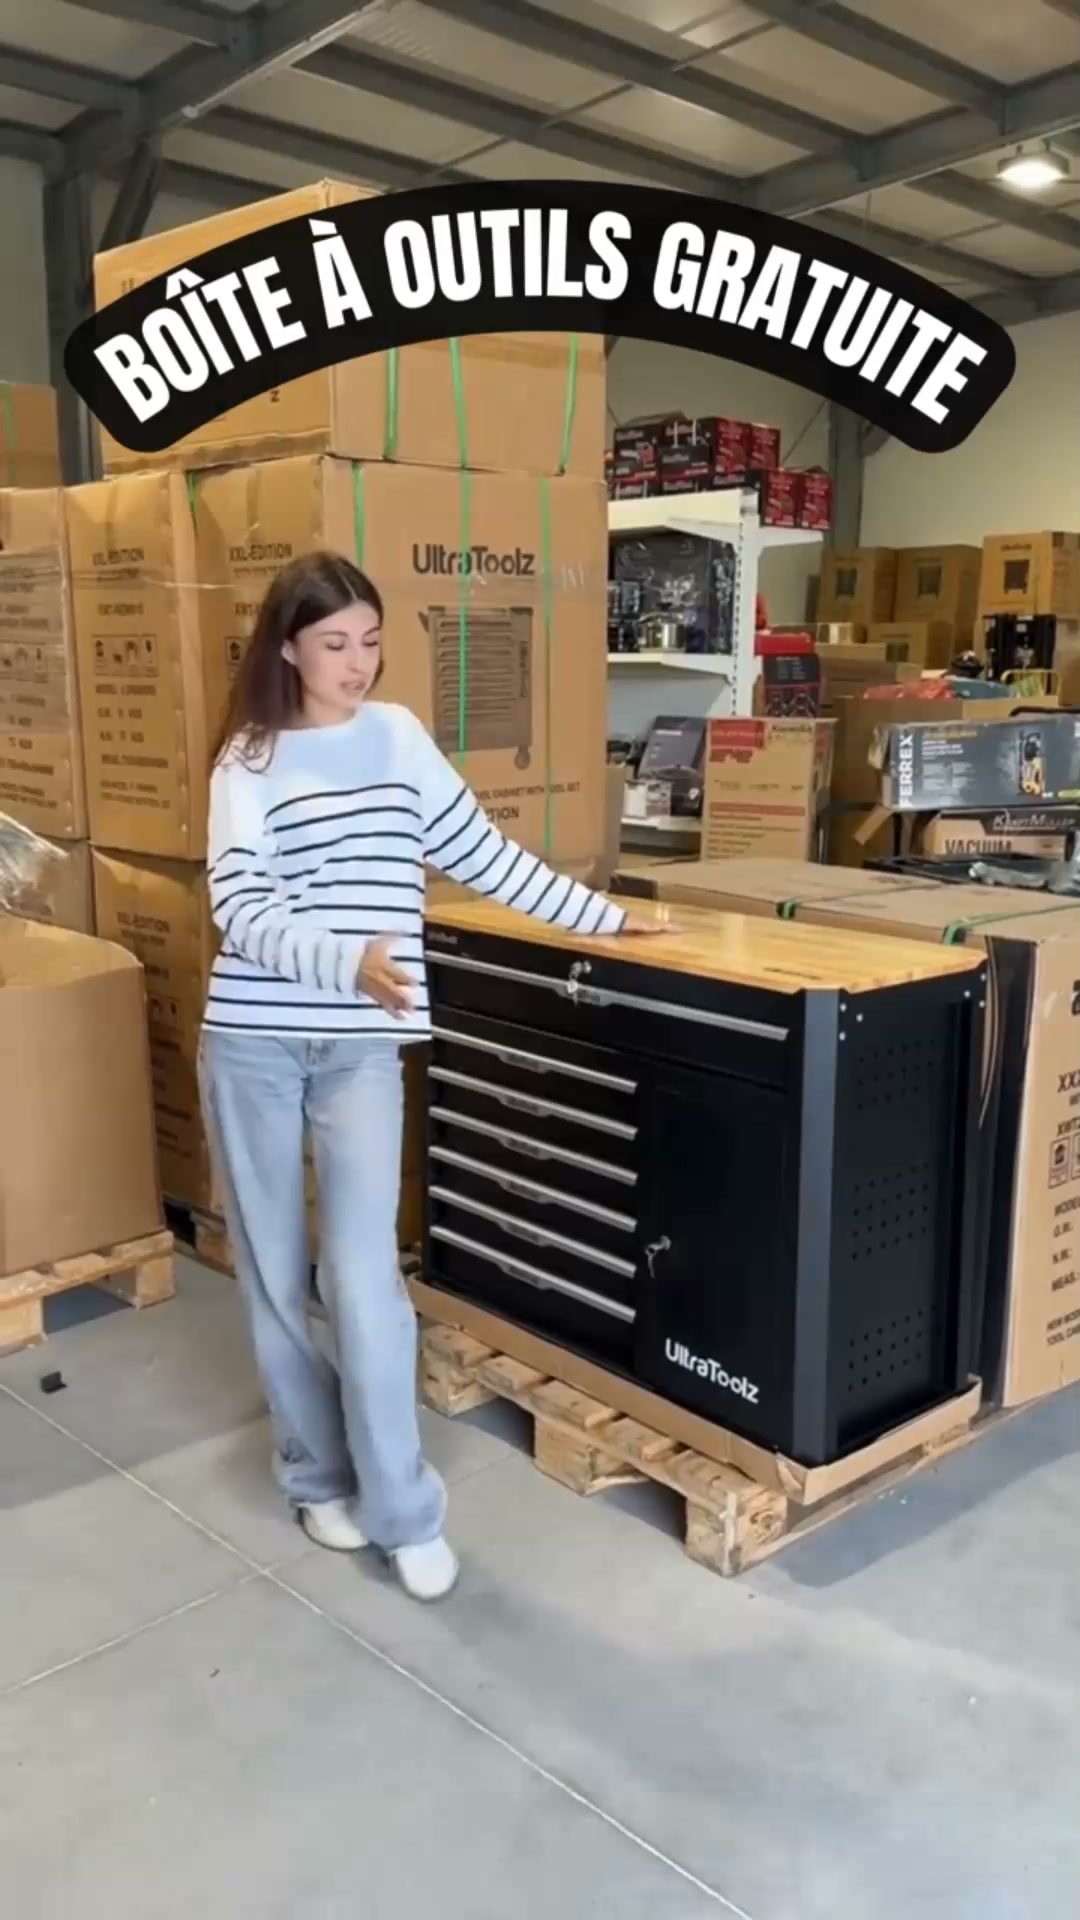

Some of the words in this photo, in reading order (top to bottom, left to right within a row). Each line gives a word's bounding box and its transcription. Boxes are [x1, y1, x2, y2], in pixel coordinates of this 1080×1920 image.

[411, 543, 536, 577] UltraToolz
[898, 733, 914, 809] FERREX
[665, 1337, 760, 1405] UltraToolz
